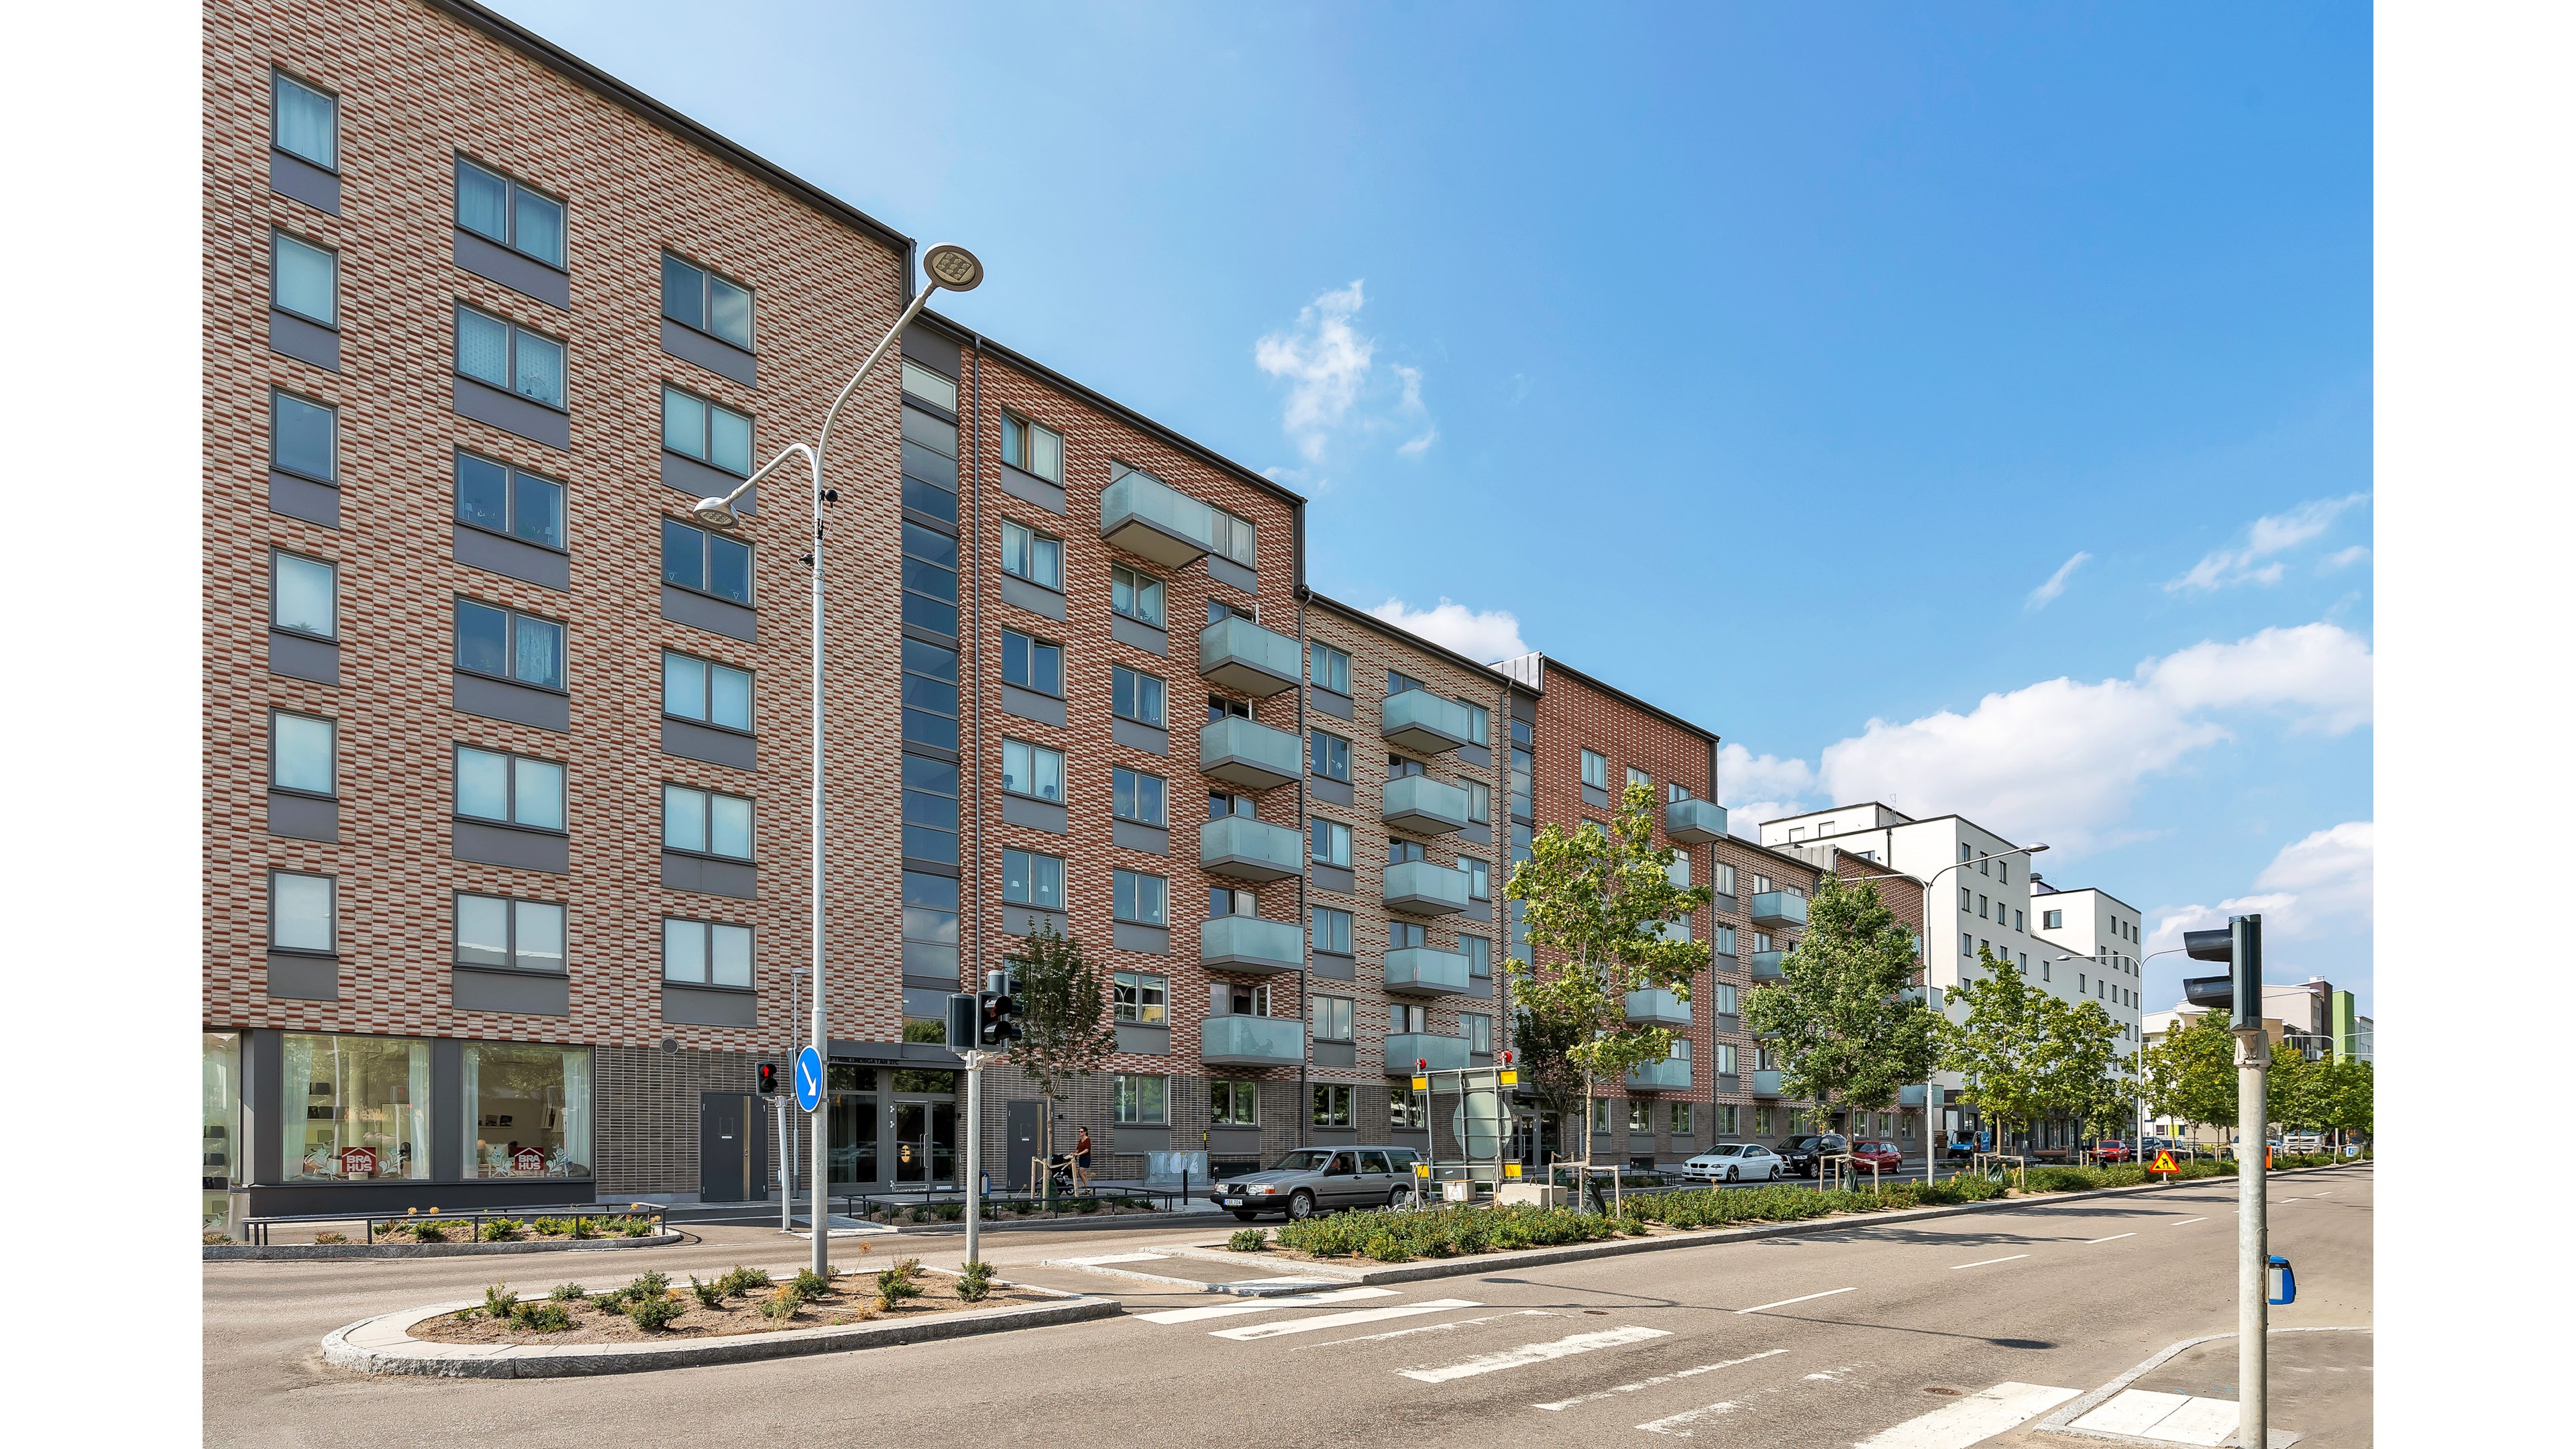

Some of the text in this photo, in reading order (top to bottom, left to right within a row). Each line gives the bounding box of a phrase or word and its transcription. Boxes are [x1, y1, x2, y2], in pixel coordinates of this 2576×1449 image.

[346, 1155, 372, 1163] BRA
[519, 1155, 541, 1163] BRA
[346, 1163, 372, 1171] HUS
